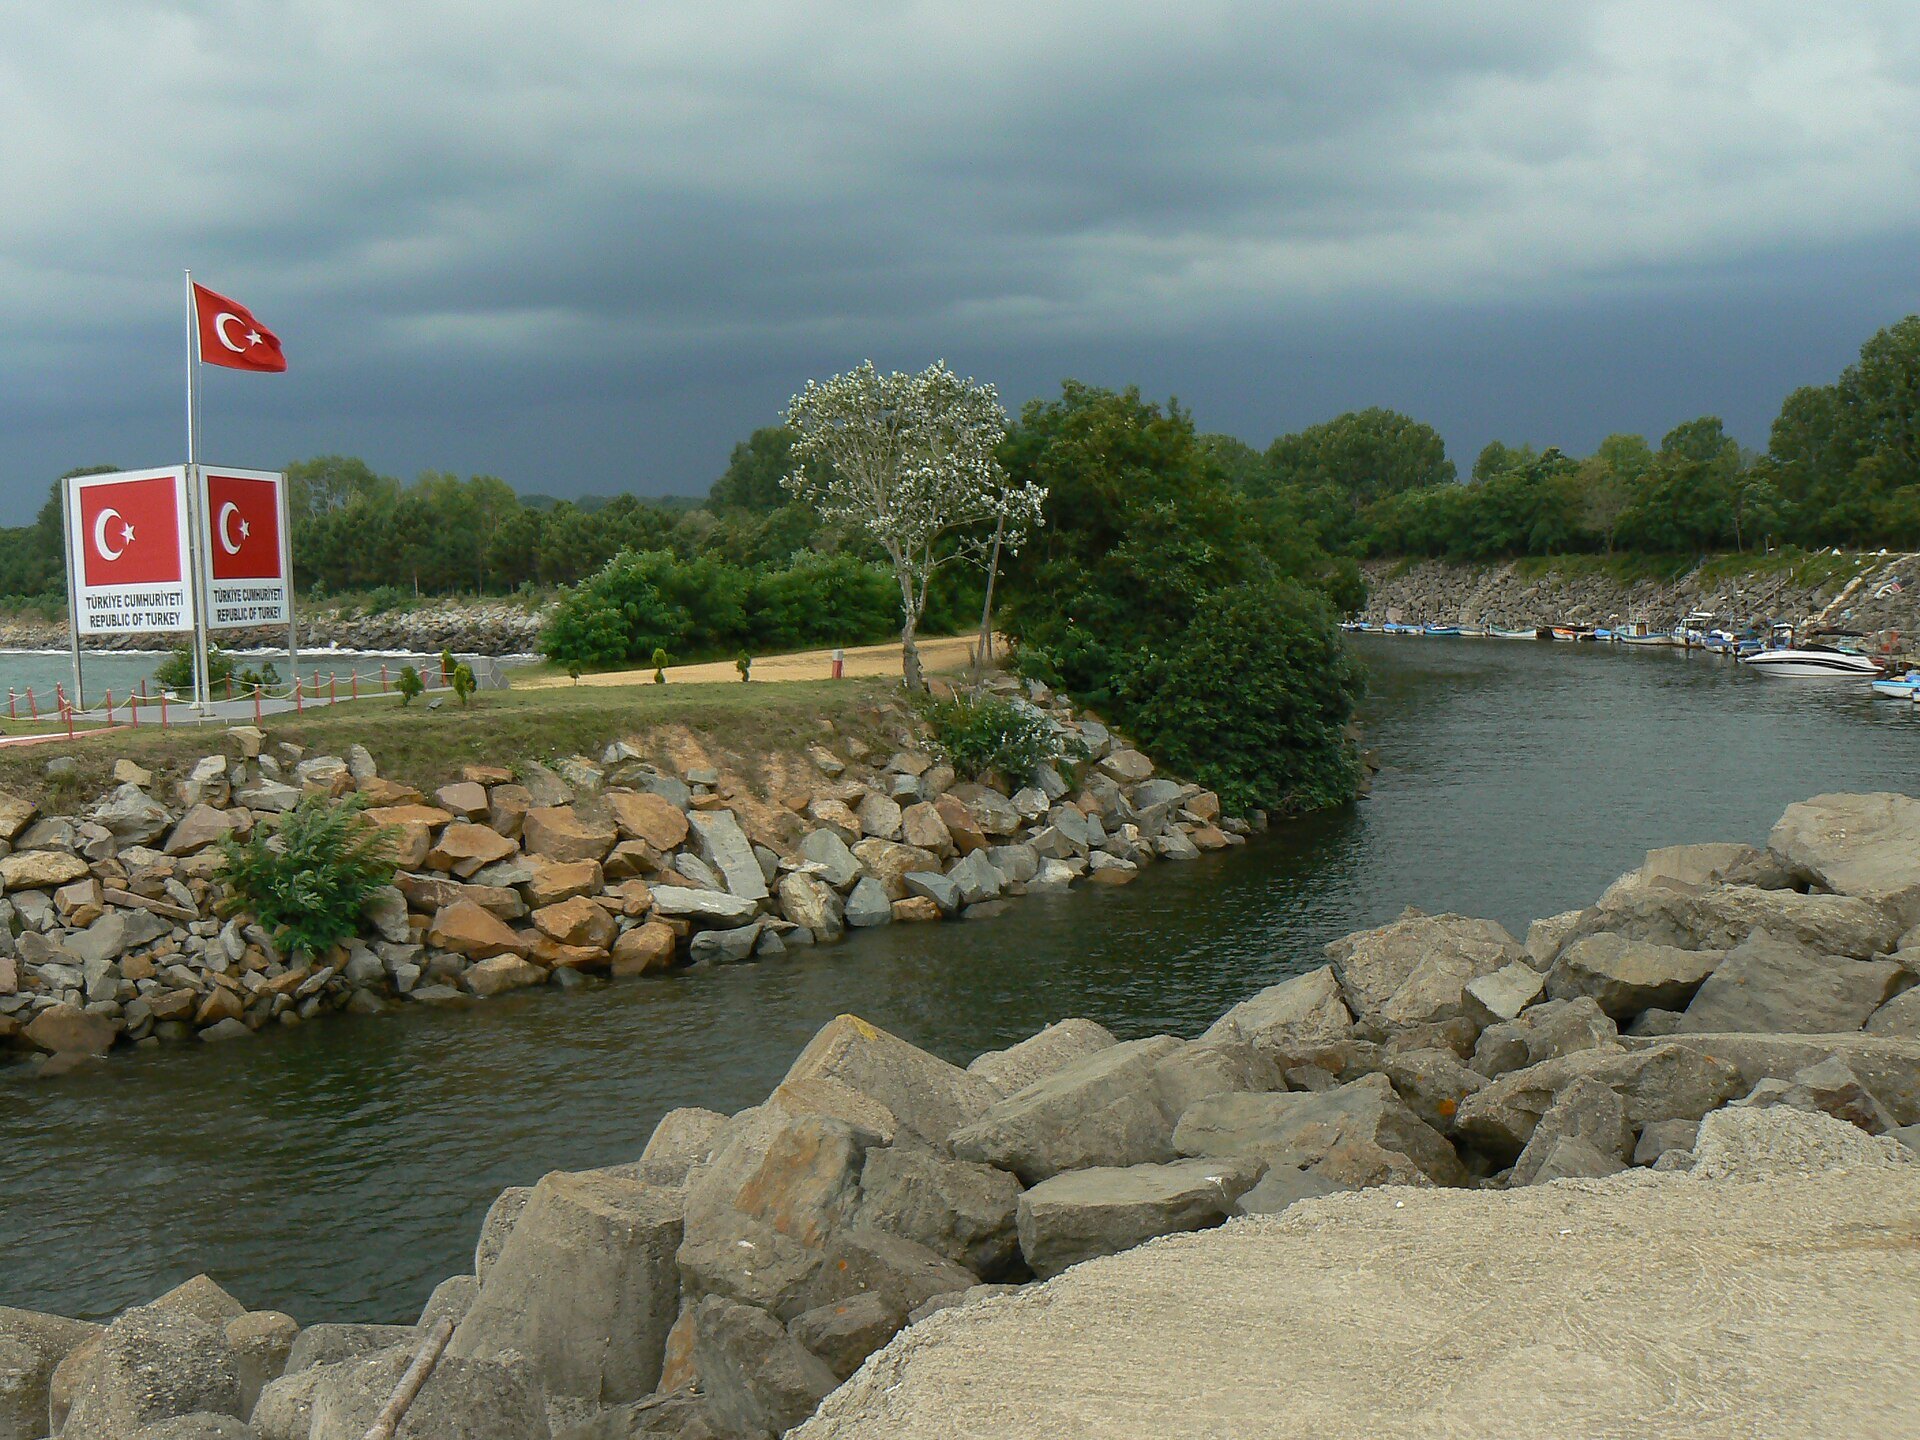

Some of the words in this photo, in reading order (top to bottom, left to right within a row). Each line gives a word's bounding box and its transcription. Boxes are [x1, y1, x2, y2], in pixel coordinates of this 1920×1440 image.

[86, 592, 122, 610] TÜRKİYE
[124, 590, 184, 608] CUMHURİYETİ
[214, 587, 242, 603] TÜRKİYE
[243, 586, 283, 602] CUMHURİYETİ
[90, 612, 130, 628] REPUBLIC
[132, 613, 144, 626] OF
[146, 611, 181, 626] TURKEY
[217, 608, 247, 622] REPUBLIC
[249, 607, 257, 620] OF
[258, 606, 282, 619] TURKEY
